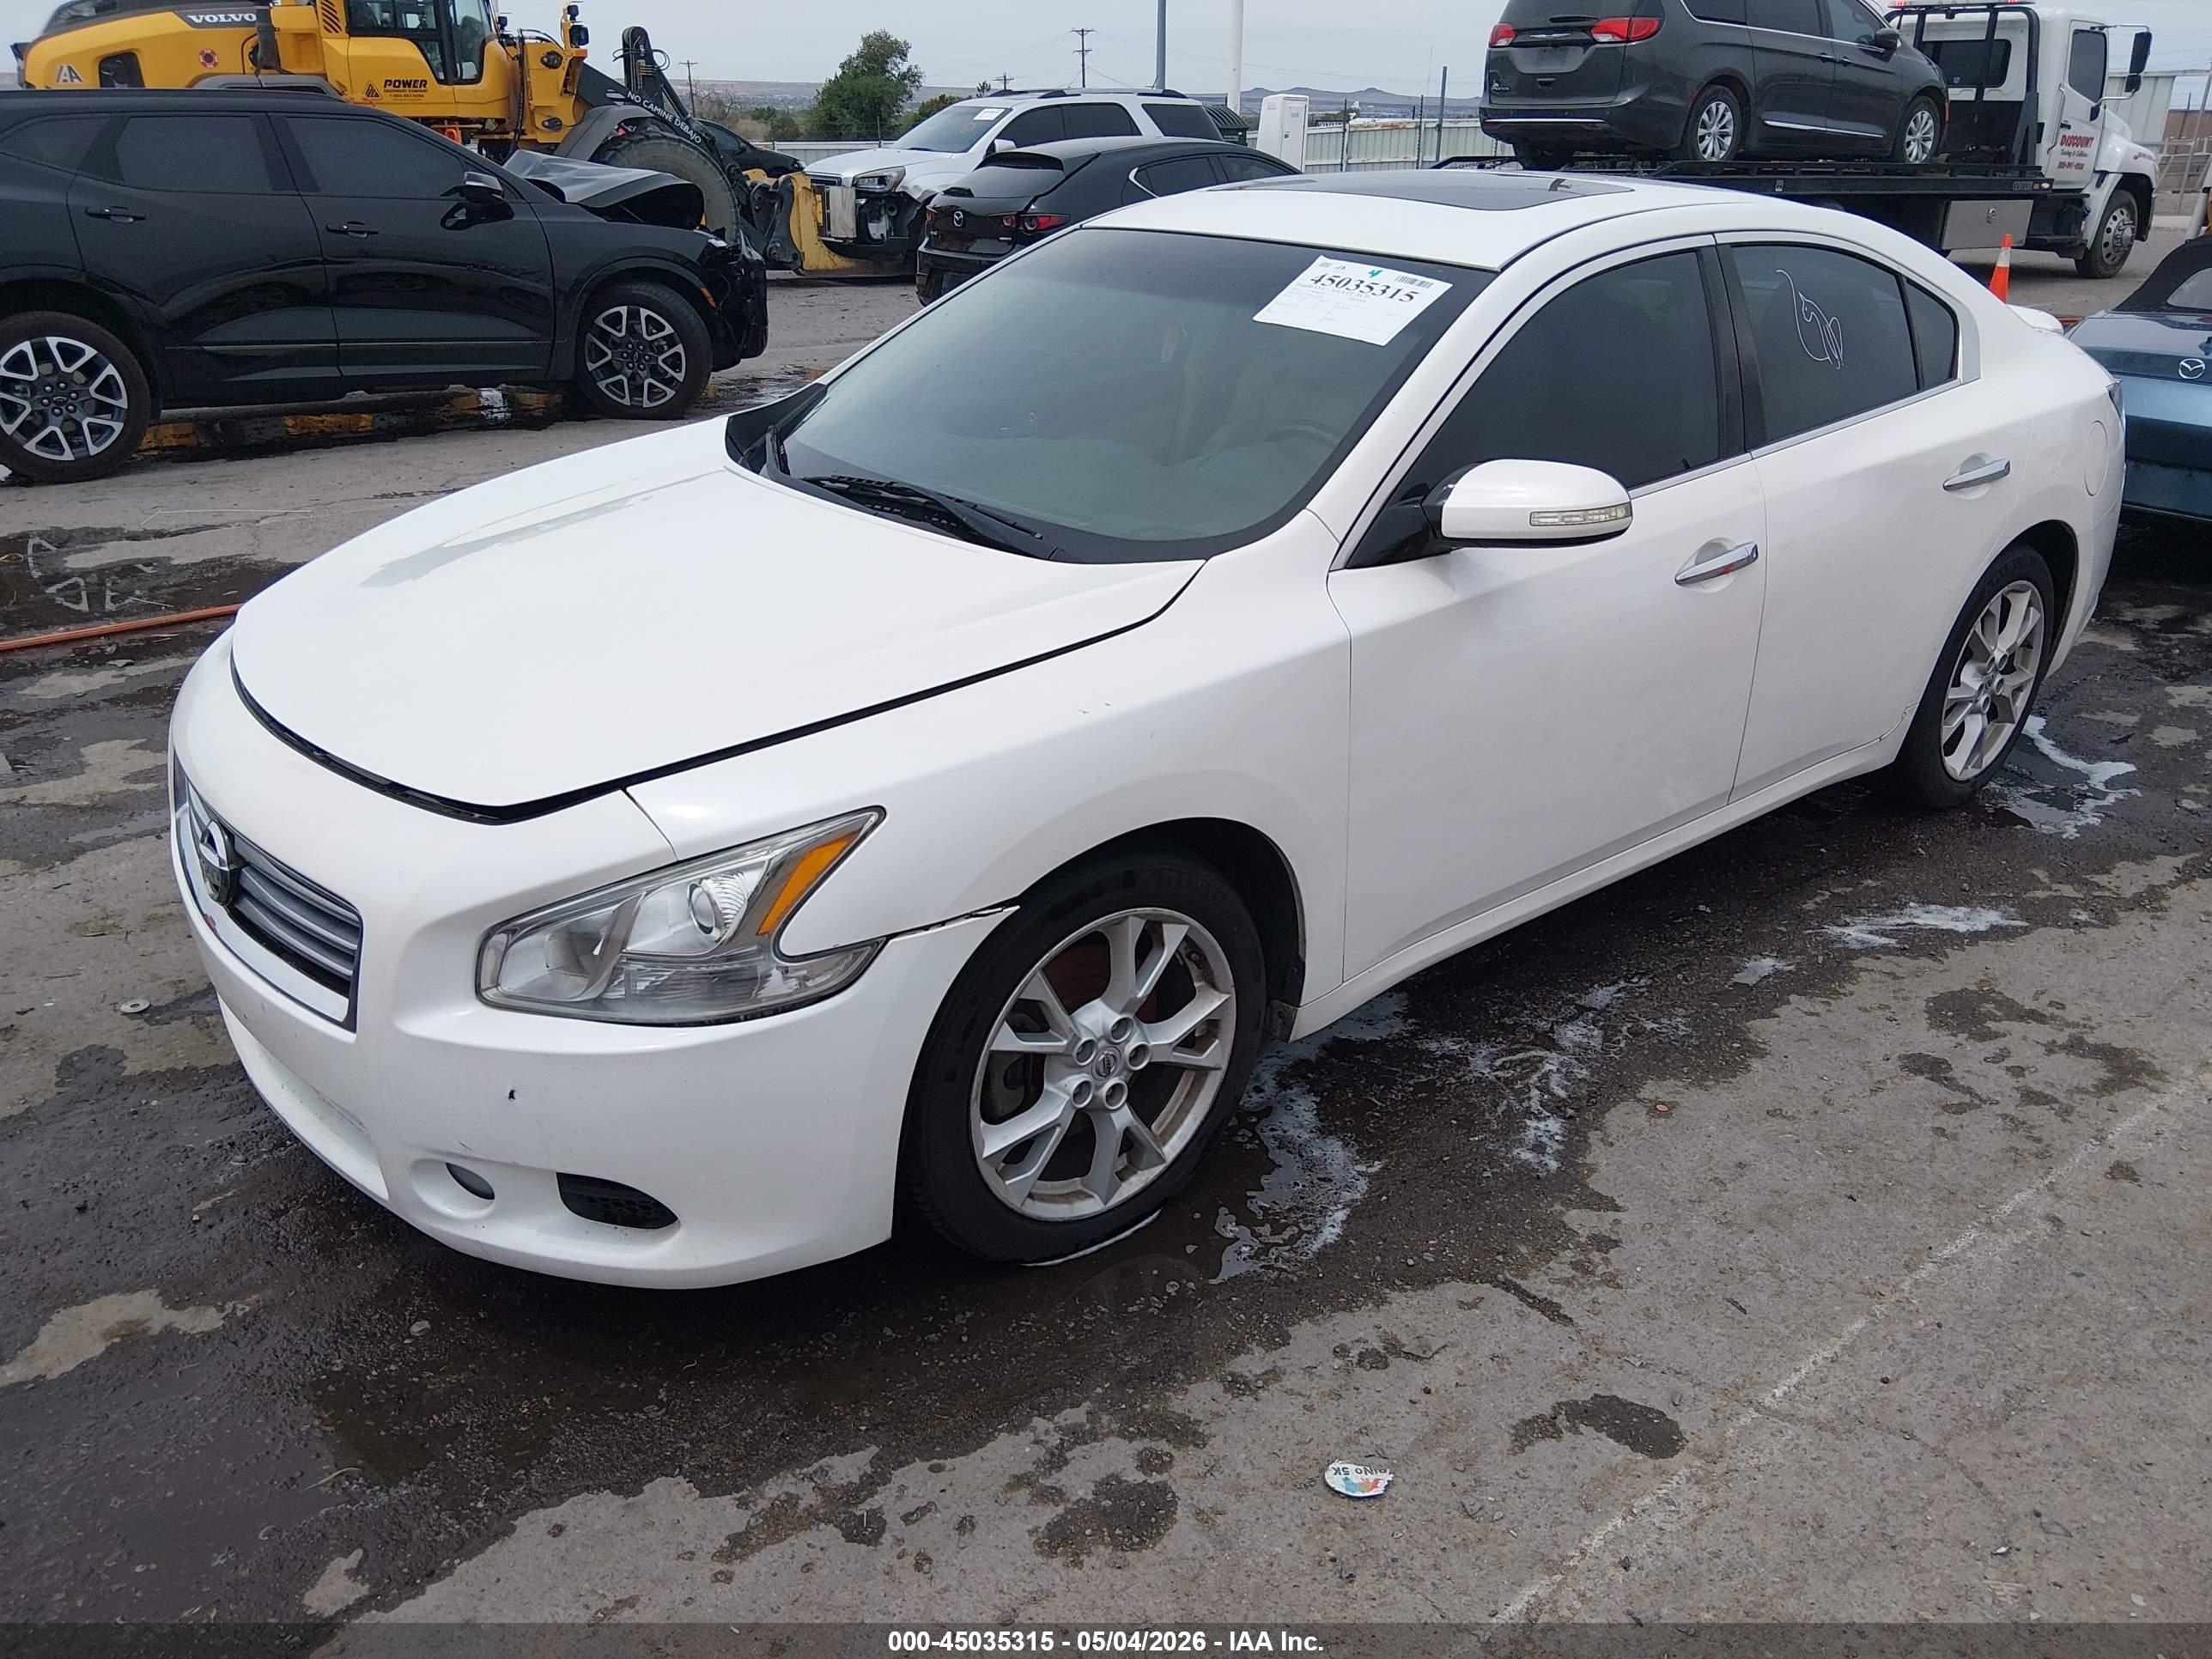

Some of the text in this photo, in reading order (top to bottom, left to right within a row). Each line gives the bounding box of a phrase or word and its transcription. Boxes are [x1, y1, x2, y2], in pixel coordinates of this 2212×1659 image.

[187, 13, 258, 24] VOLVO
[383, 79, 428, 89] POWER
[627, 91, 702, 143] NO CAMINE DEBAJO
[2060, 134, 2094, 149] DISCOUNT
[1310, 273, 1419, 302] 45035315
[1332, 1466, 1350, 1476] 5K
